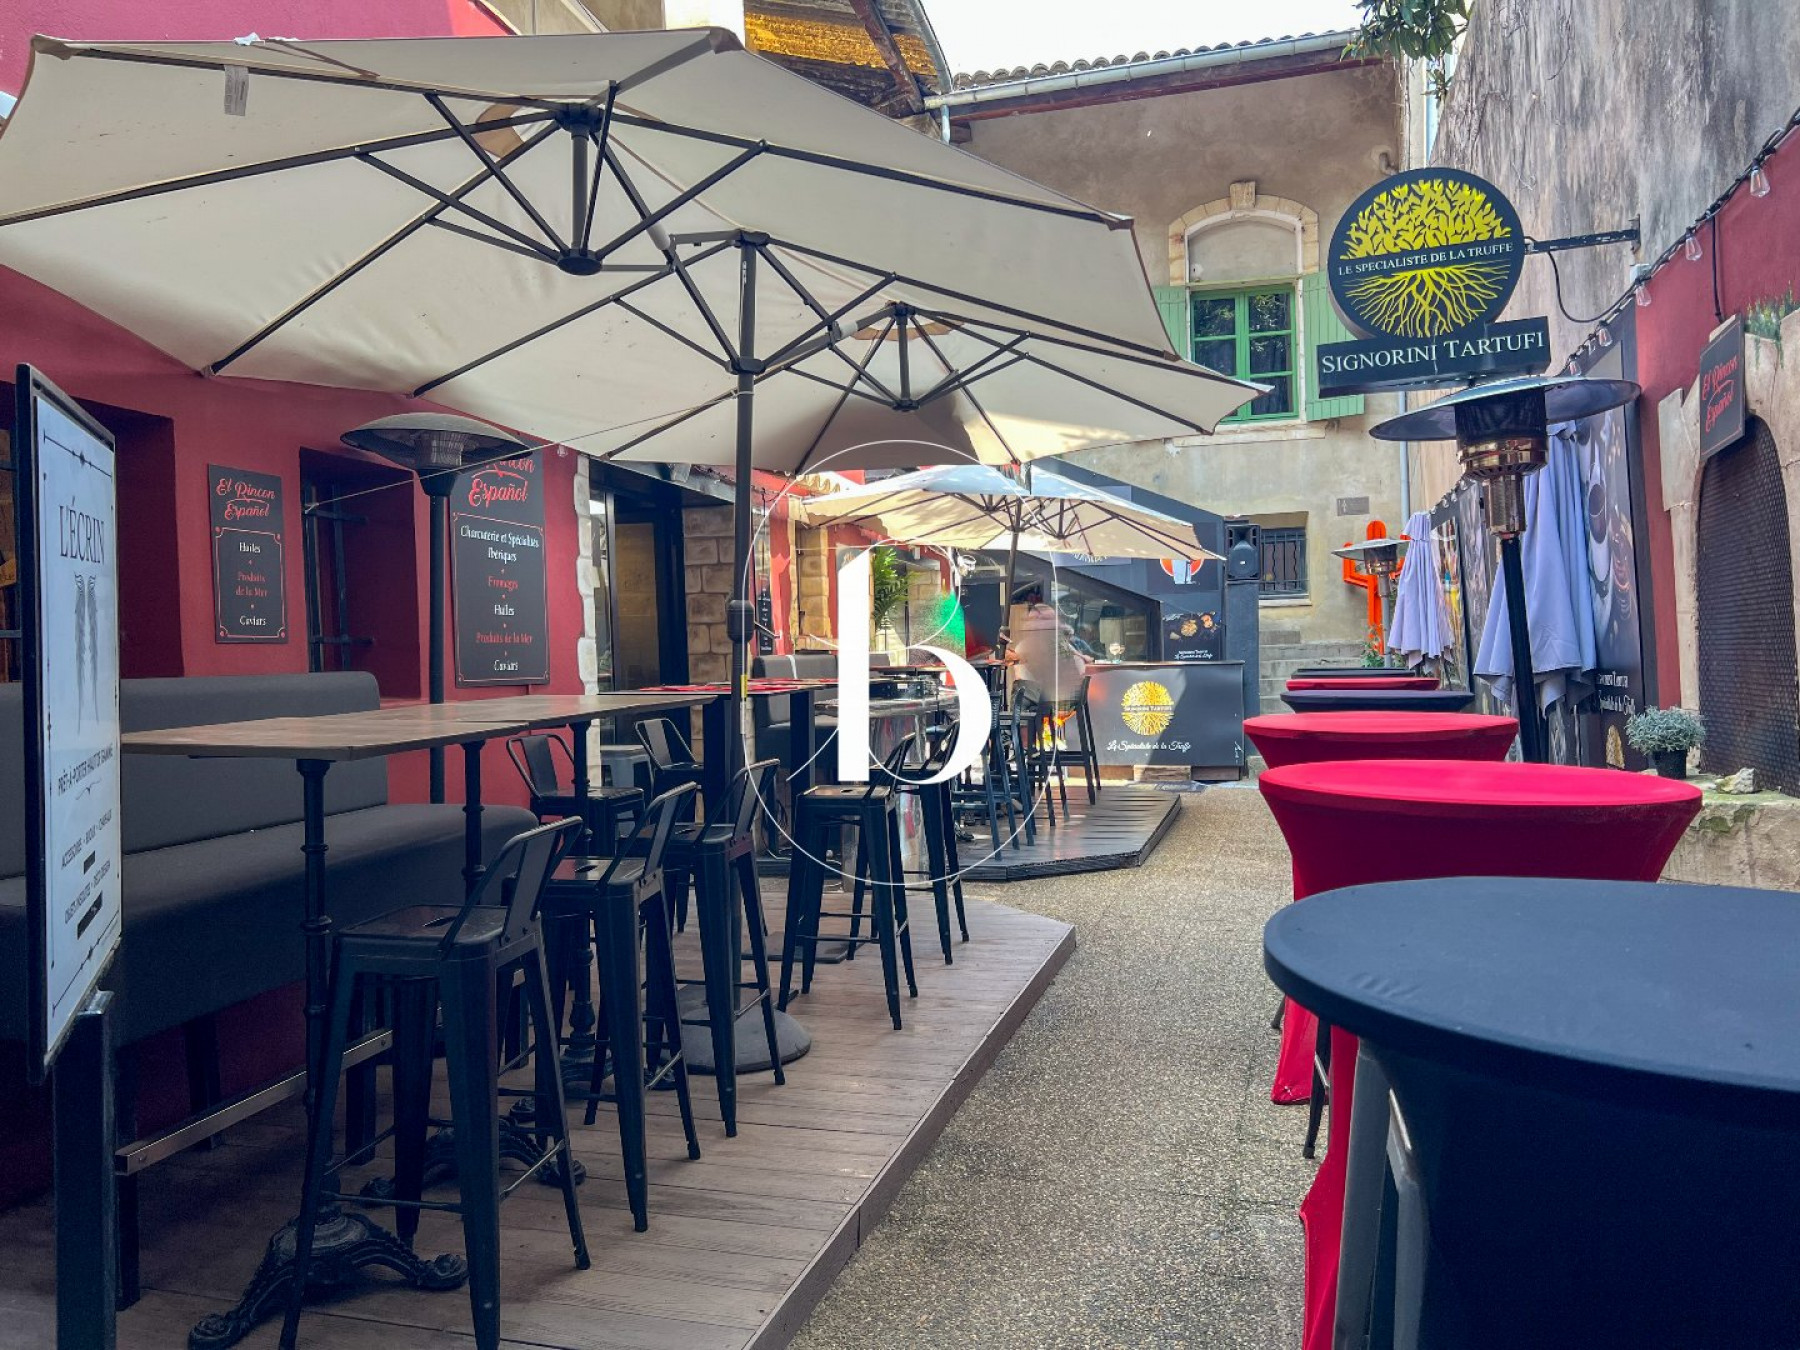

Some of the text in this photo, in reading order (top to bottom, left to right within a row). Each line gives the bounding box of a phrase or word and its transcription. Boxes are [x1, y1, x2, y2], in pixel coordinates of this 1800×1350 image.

[1338, 242, 1513, 276] LE SPECIALISTE DE LA TRUFFE
[1321, 331, 1544, 374] SIGNORINI TARTUFI
[216, 478, 275, 499] El Rincon
[469, 479, 529, 508] Español
[224, 503, 270, 520] Español
[59, 495, 104, 564] L'ÉCRIN
[239, 542, 261, 553] Huiles
